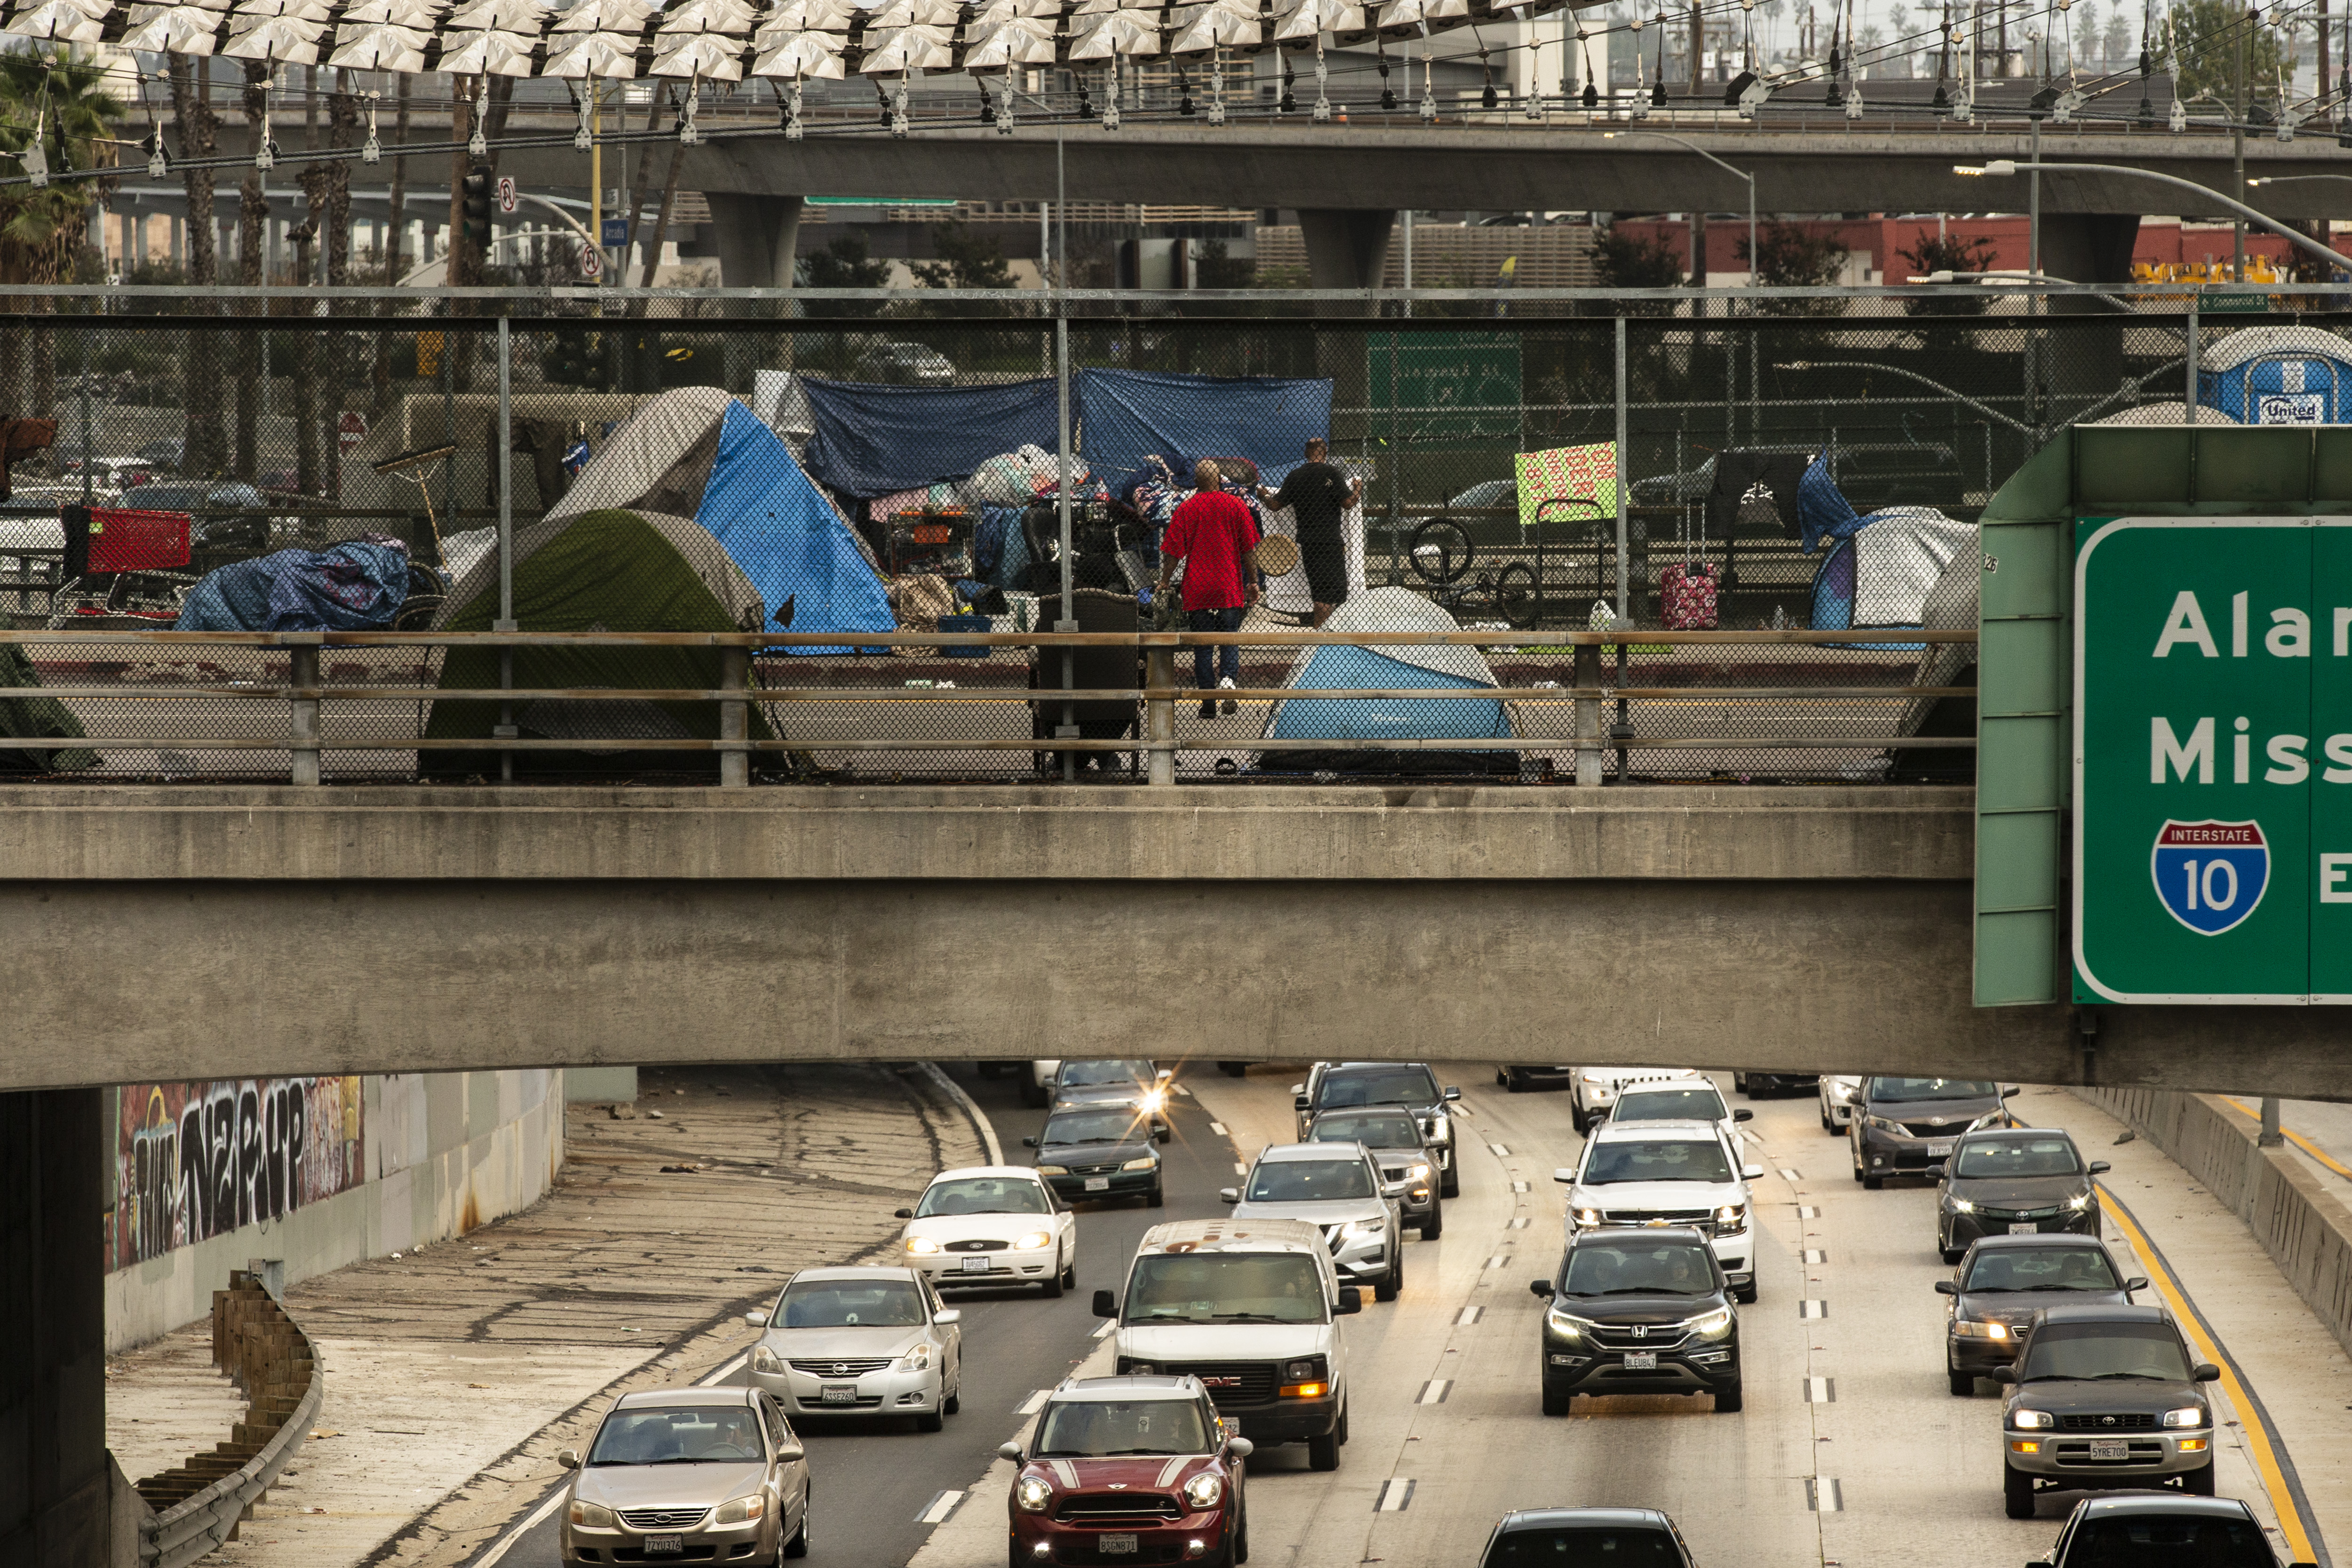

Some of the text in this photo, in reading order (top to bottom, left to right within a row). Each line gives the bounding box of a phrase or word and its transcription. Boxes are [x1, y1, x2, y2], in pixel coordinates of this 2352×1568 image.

[2268, 403, 2315, 416] United
[2151, 716, 2352, 785] Miss
[2171, 830, 2251, 841] INTERSTATE
[2184, 858, 2238, 911] 10
[1626, 1358, 1655, 1367] 8LEU847
[1202, 1377, 1241, 1386] GMC
[2093, 1447, 2126, 1457] 5YRE700
[646, 1540, 681, 1551] 7ZYU376
[1101, 1541, 1136, 1551] 8SGN871
